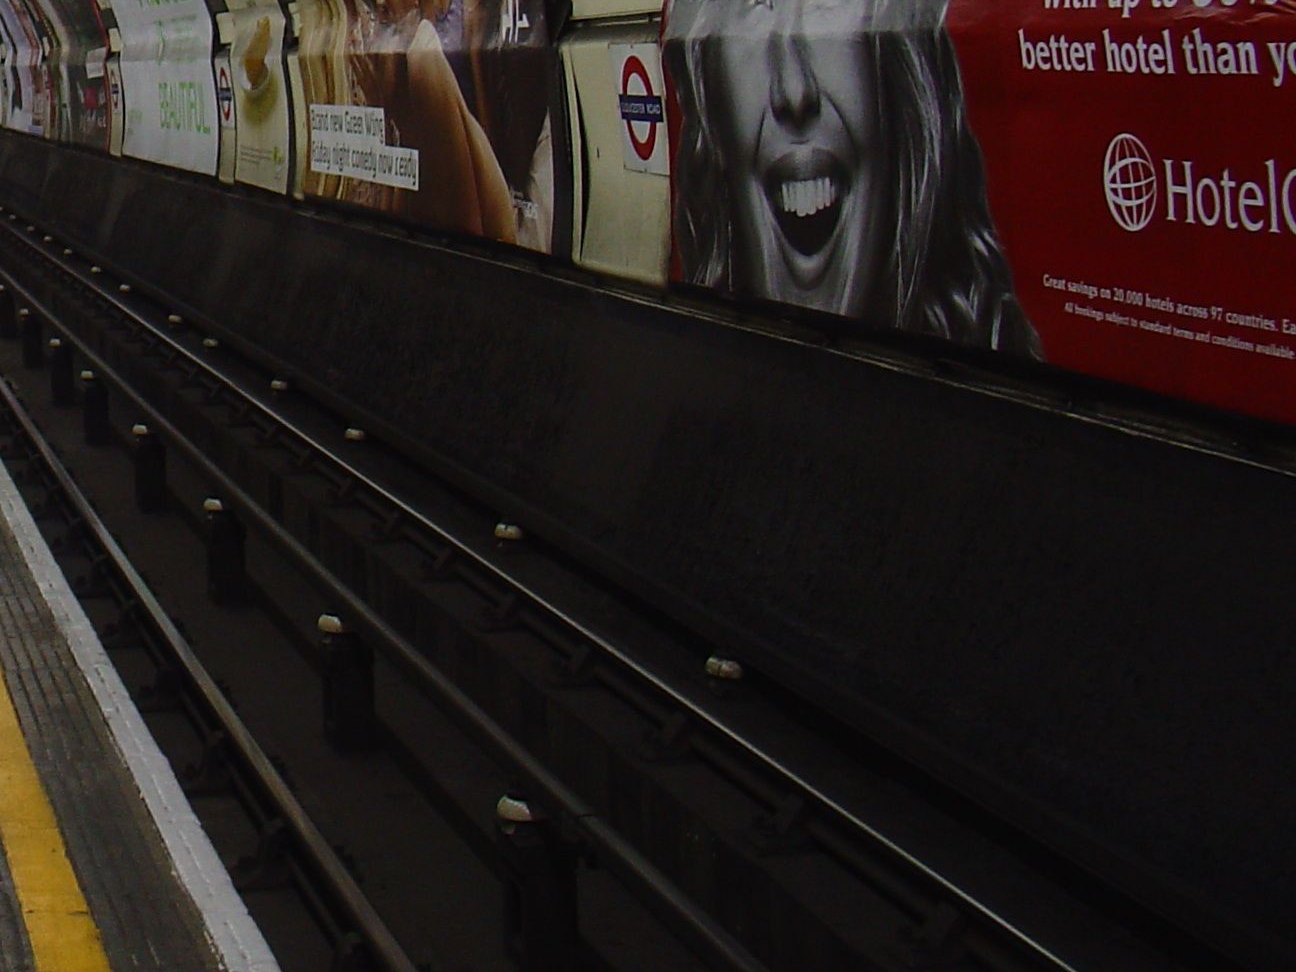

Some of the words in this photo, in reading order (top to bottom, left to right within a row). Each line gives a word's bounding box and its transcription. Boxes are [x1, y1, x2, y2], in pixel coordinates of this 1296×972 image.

[1018, 28, 1096, 71] better
[1102, 28, 1176, 74] hotel
[1182, 28, 1259, 75] than
[330, 113, 343, 132] new
[344, 110, 364, 134] Green
[364, 111, 384, 144] Wing
[332, 141, 351, 172] night
[352, 147, 377, 179] comedy
[378, 153, 394, 175] now
[394, 150, 418, 187] ready
[1043, 273, 1066, 291] Great
[1067, 279, 1099, 299] savings
[1100, 287, 1112, 300] on
[1145, 293, 1175, 314] hotels
[1176, 303, 1209, 319] across
[1210, 306, 1224, 322] 97
[1064, 301, 1074, 314] All
[1074, 302, 1105, 322] bookings
[1105, 309, 1130, 327] subject
[1139, 318, 1172, 336] standard
[1173, 326, 1195, 341] terms
[1195, 329, 1210, 344] and
[1212, 333, 1255, 352] conditions
[1255, 343, 1295, 360] available
